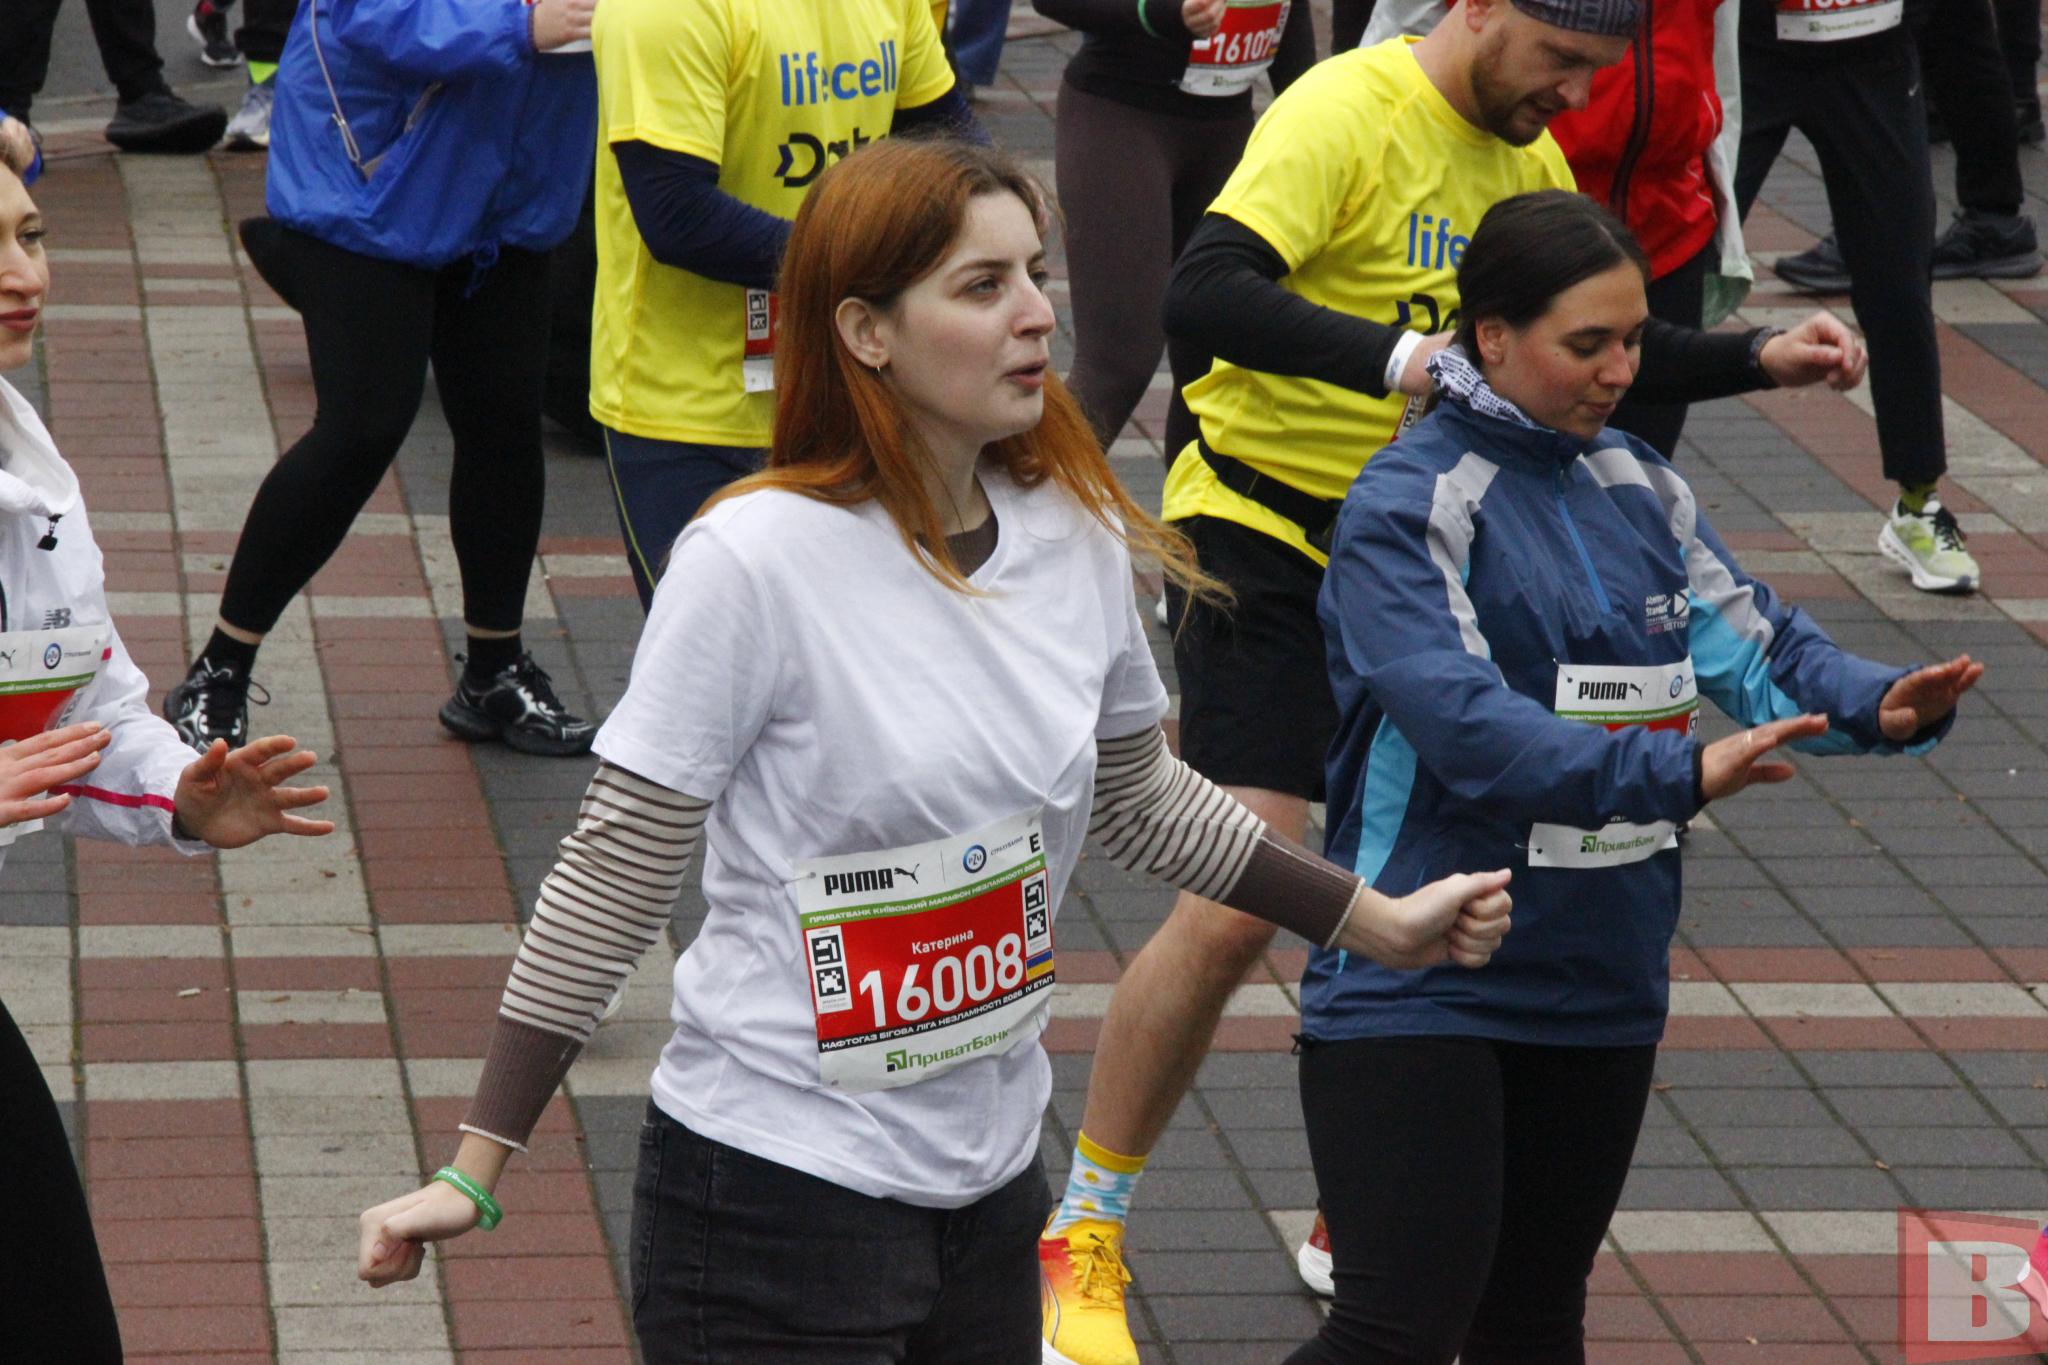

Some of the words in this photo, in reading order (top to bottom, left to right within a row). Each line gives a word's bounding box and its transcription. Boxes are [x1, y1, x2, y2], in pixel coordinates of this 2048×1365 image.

[1578, 682, 1628, 701] PUMA
[824, 868, 894, 896] PUMA
[911, 930, 974, 955] Катерина
[859, 932, 1024, 1028] 16008
[821, 1033, 878, 1050] НАФТОГАЗ
[879, 1027, 914, 1040] БІГОВА
[916, 1020, 937, 1032] ЛІГА
[938, 999, 1002, 1026] НЕЗЛАМНОСТІ
[1033, 975, 1053, 989] ЕТАП
[909, 1029, 1009, 1069] ПриватБанк
